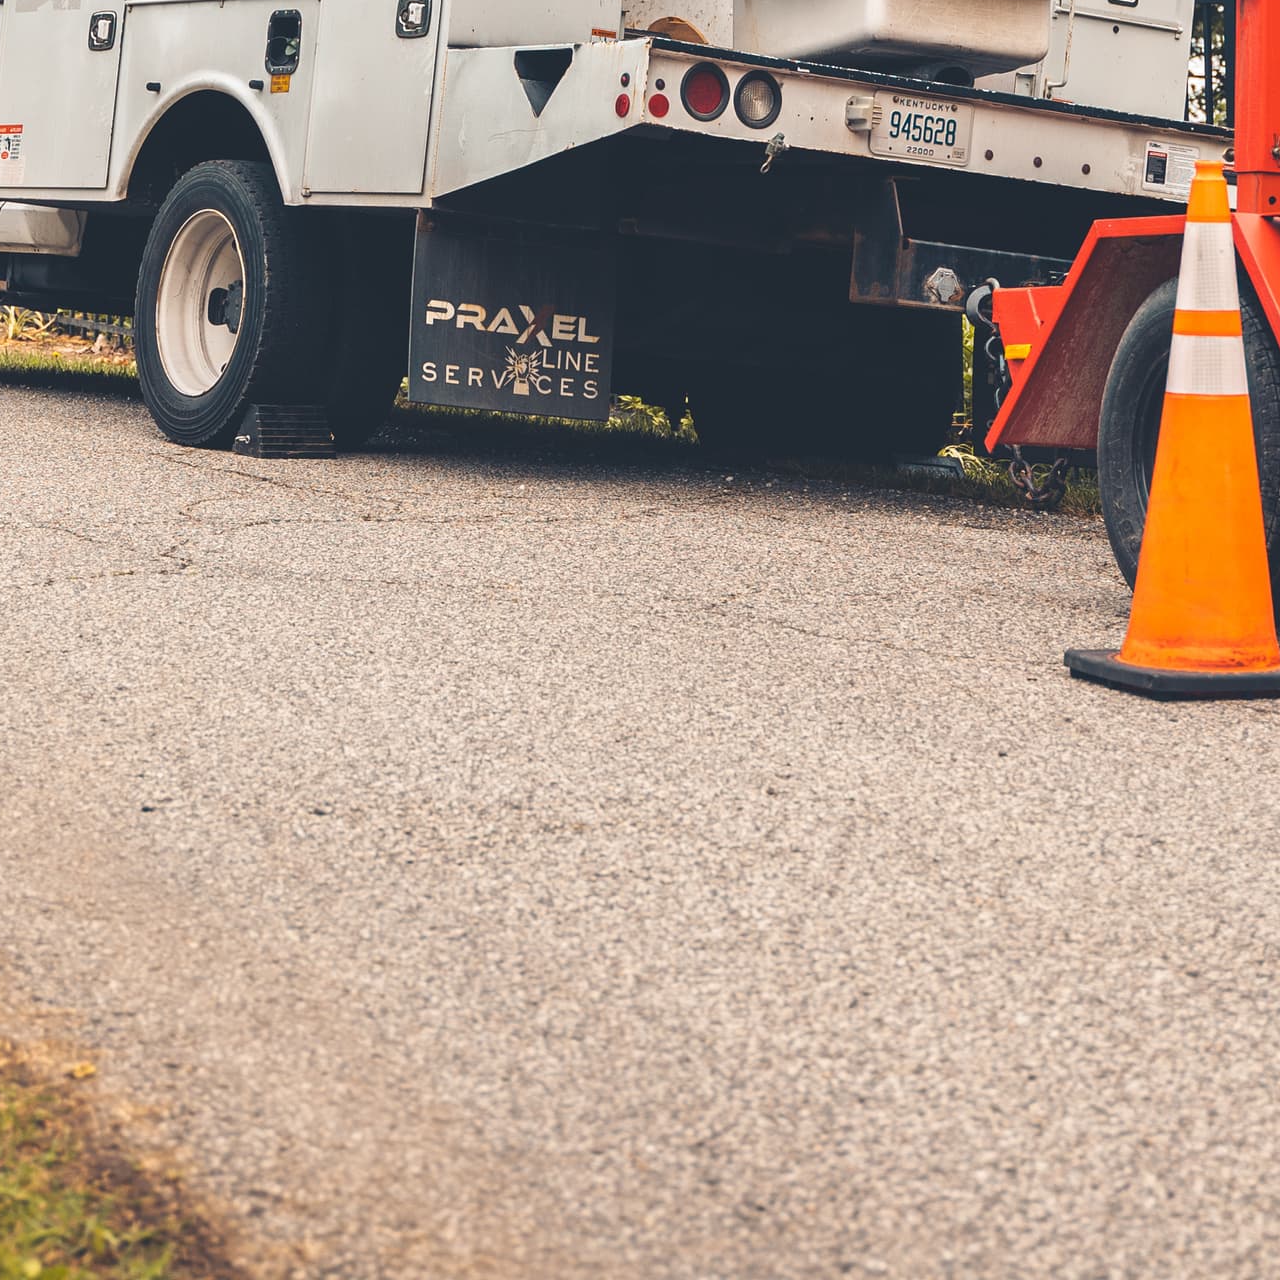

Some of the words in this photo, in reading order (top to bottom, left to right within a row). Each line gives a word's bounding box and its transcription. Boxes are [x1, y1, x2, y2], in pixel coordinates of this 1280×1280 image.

[900, 97, 951, 112] KENTUCKY
[889, 110, 957, 146] 945628
[906, 145, 935, 156] 22000
[425, 299, 600, 347] PRAXEL
[541, 348, 600, 373] LINE
